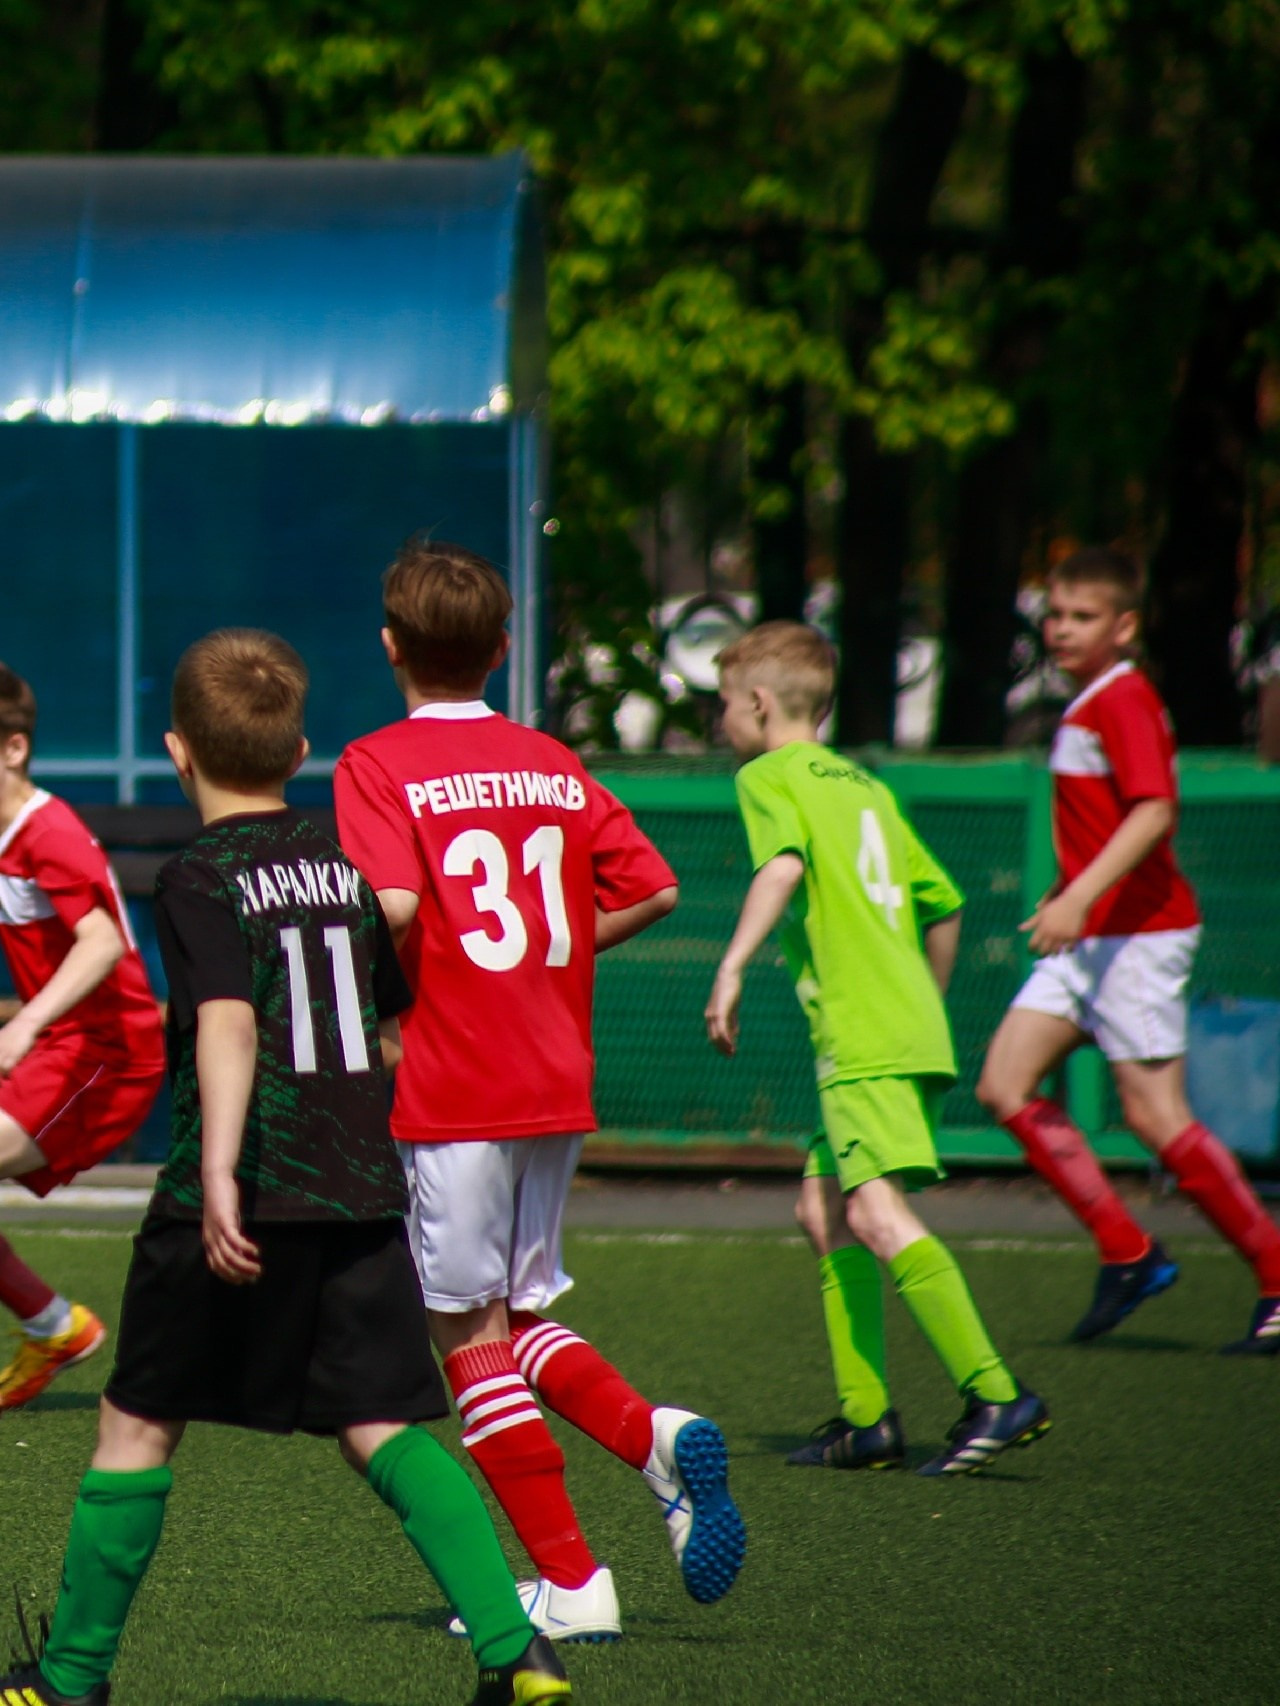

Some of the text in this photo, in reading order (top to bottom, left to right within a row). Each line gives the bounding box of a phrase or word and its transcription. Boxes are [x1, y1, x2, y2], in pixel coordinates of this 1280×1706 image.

[404, 771, 586, 818] РЕШЕТНИКОВ
[443, 826, 571, 972] 31
[857, 809, 903, 932] 4
[280, 926, 370, 1072] 11
